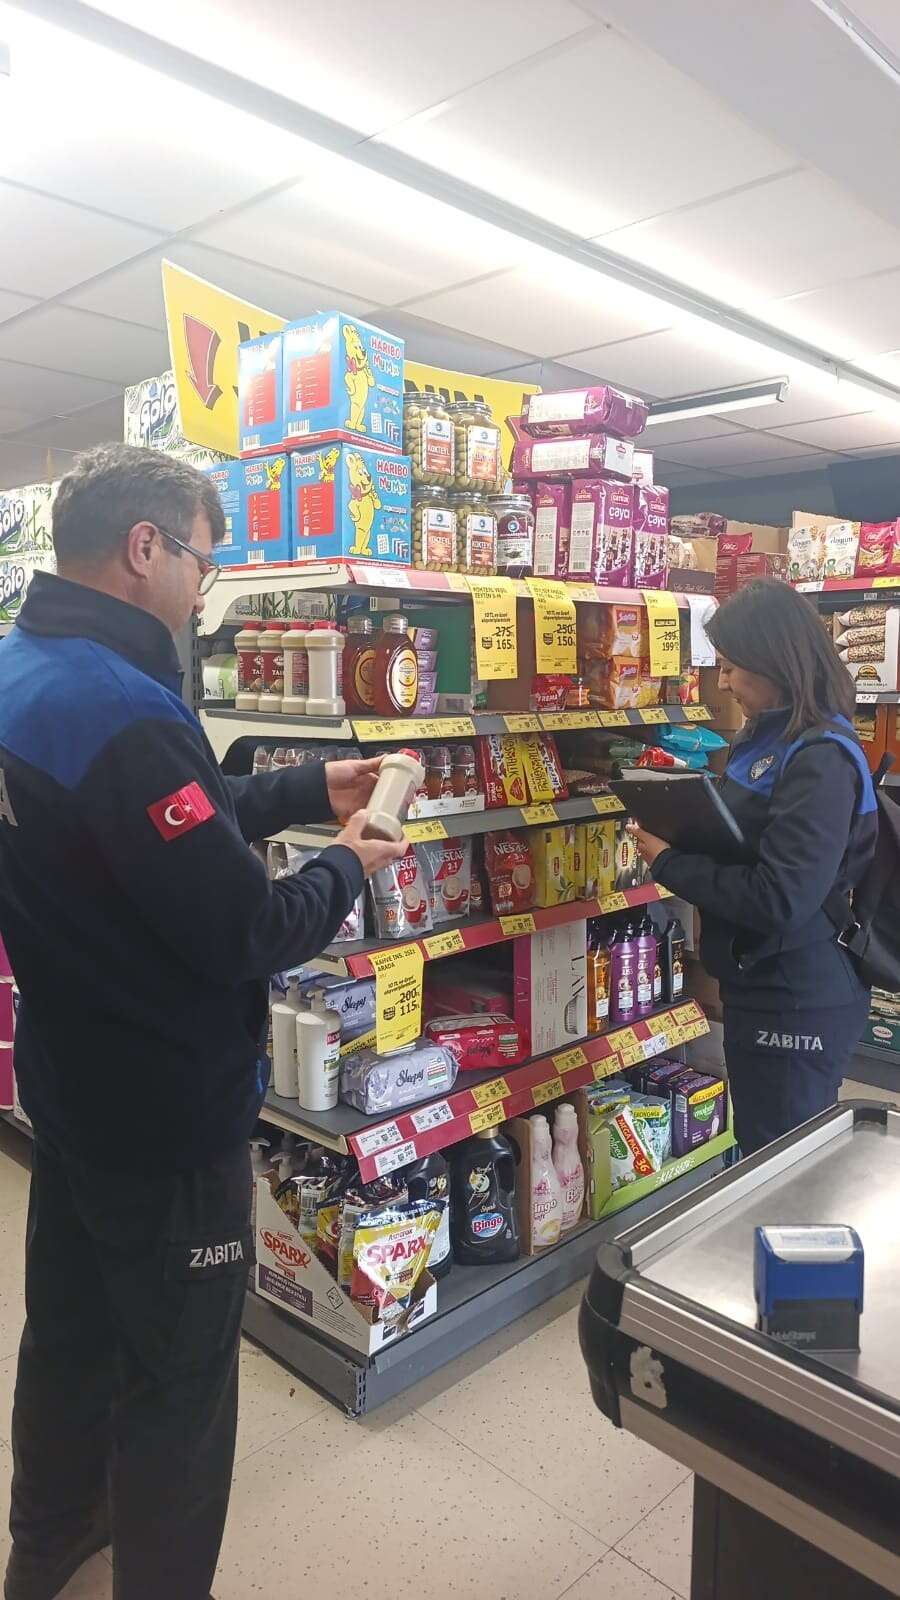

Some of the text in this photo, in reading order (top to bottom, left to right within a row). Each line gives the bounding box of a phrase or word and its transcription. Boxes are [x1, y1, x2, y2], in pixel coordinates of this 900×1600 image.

[371, 335, 400, 359] HARIBO
[377, 459, 409, 478] HARIBO
[495, 627, 511, 637] 275
[557, 624, 573, 635] 250
[496, 639, 511, 650] 165
[557, 637, 573, 646] 150
[663, 642, 674, 651] 199
[490, 734, 502, 762] kram
[430, 850, 465, 864] NESCAF
[375, 954, 393, 966] KAHVE
[377, 961, 395, 972] ARADA
[341, 996, 367, 1013] Sleepy
[400, 988, 417, 1004] 200
[400, 1000, 416, 1017] 115
[757, 1030, 823, 1050] ZABITA
[396, 1069, 425, 1087] Sleepy
[617, 1118, 641, 1156] MEGA PACK
[636, 1158, 650, 1173] 36
[534, 1199, 557, 1215] ingo
[473, 1216, 504, 1233] Bingo
[190, 1240, 244, 1267] ZABITA
[264, 1231, 307, 1266] SPARX
[367, 1235, 426, 1264] SPARX
